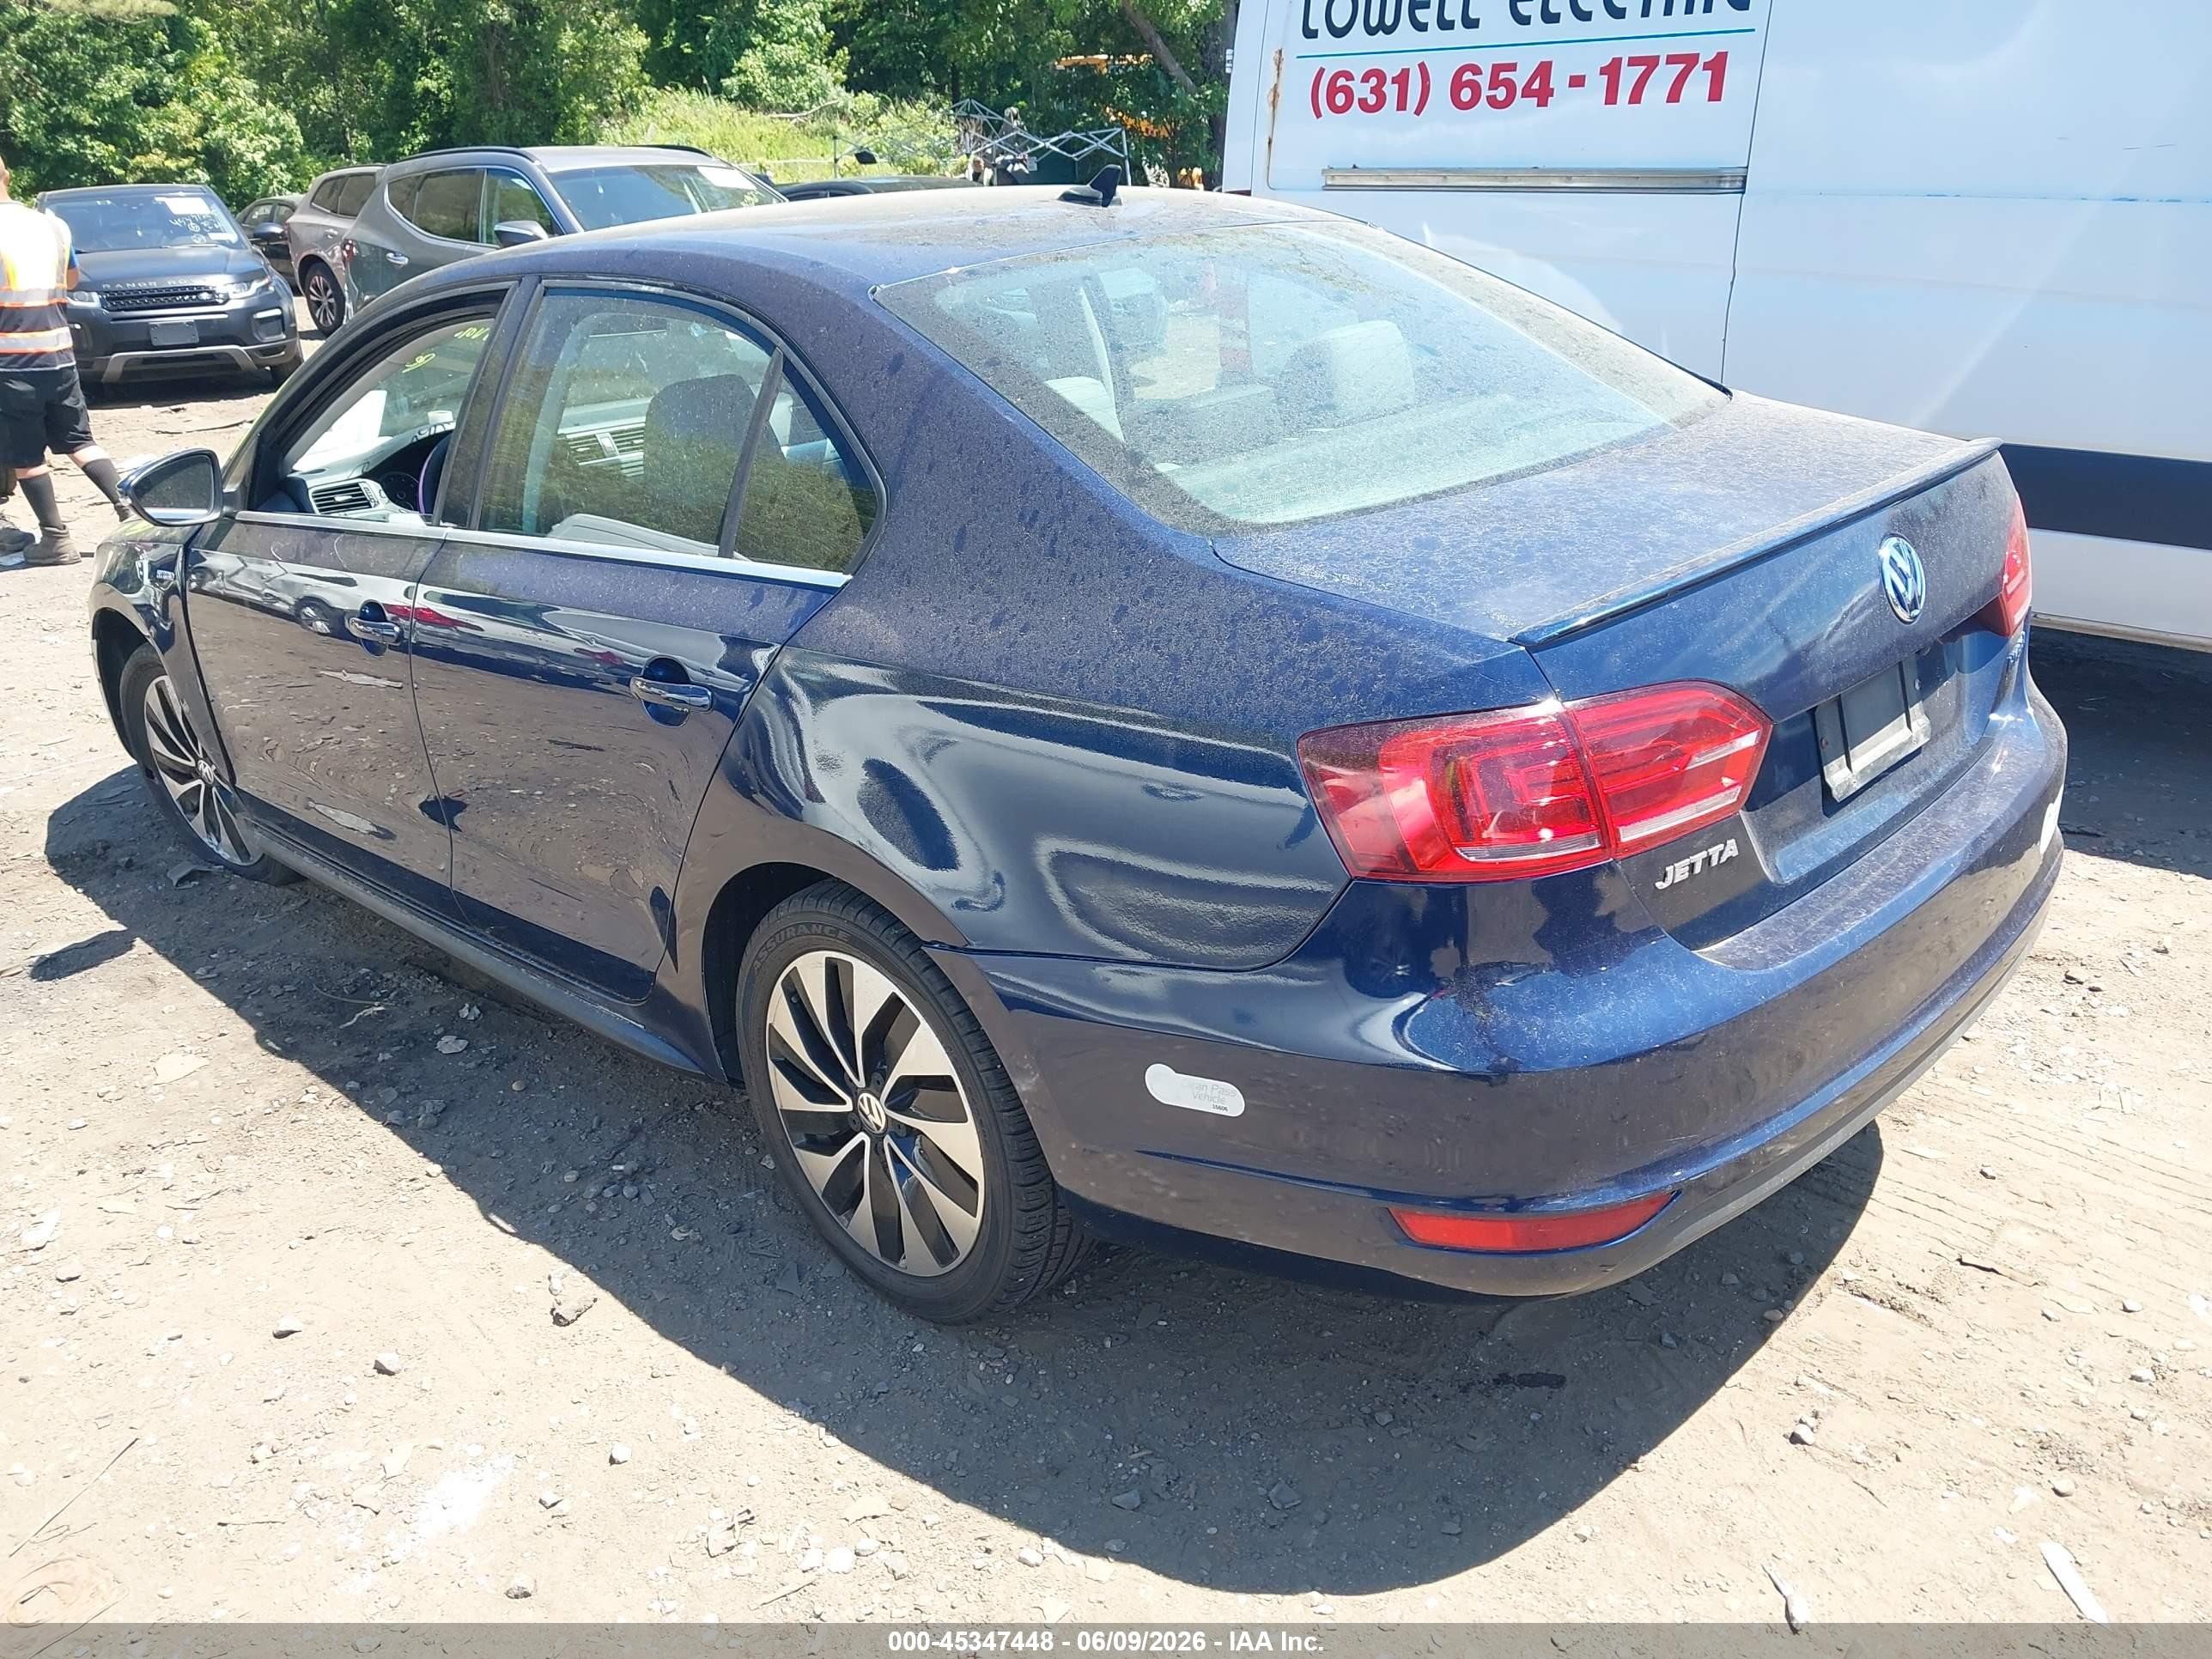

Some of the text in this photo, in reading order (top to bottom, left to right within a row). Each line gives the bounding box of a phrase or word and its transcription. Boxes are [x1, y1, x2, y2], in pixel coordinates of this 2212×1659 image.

[1311, 62, 1431, 118] (631)
[1655, 838, 1739, 890] JETTA
[753, 923, 852, 971] ASSURANCE
